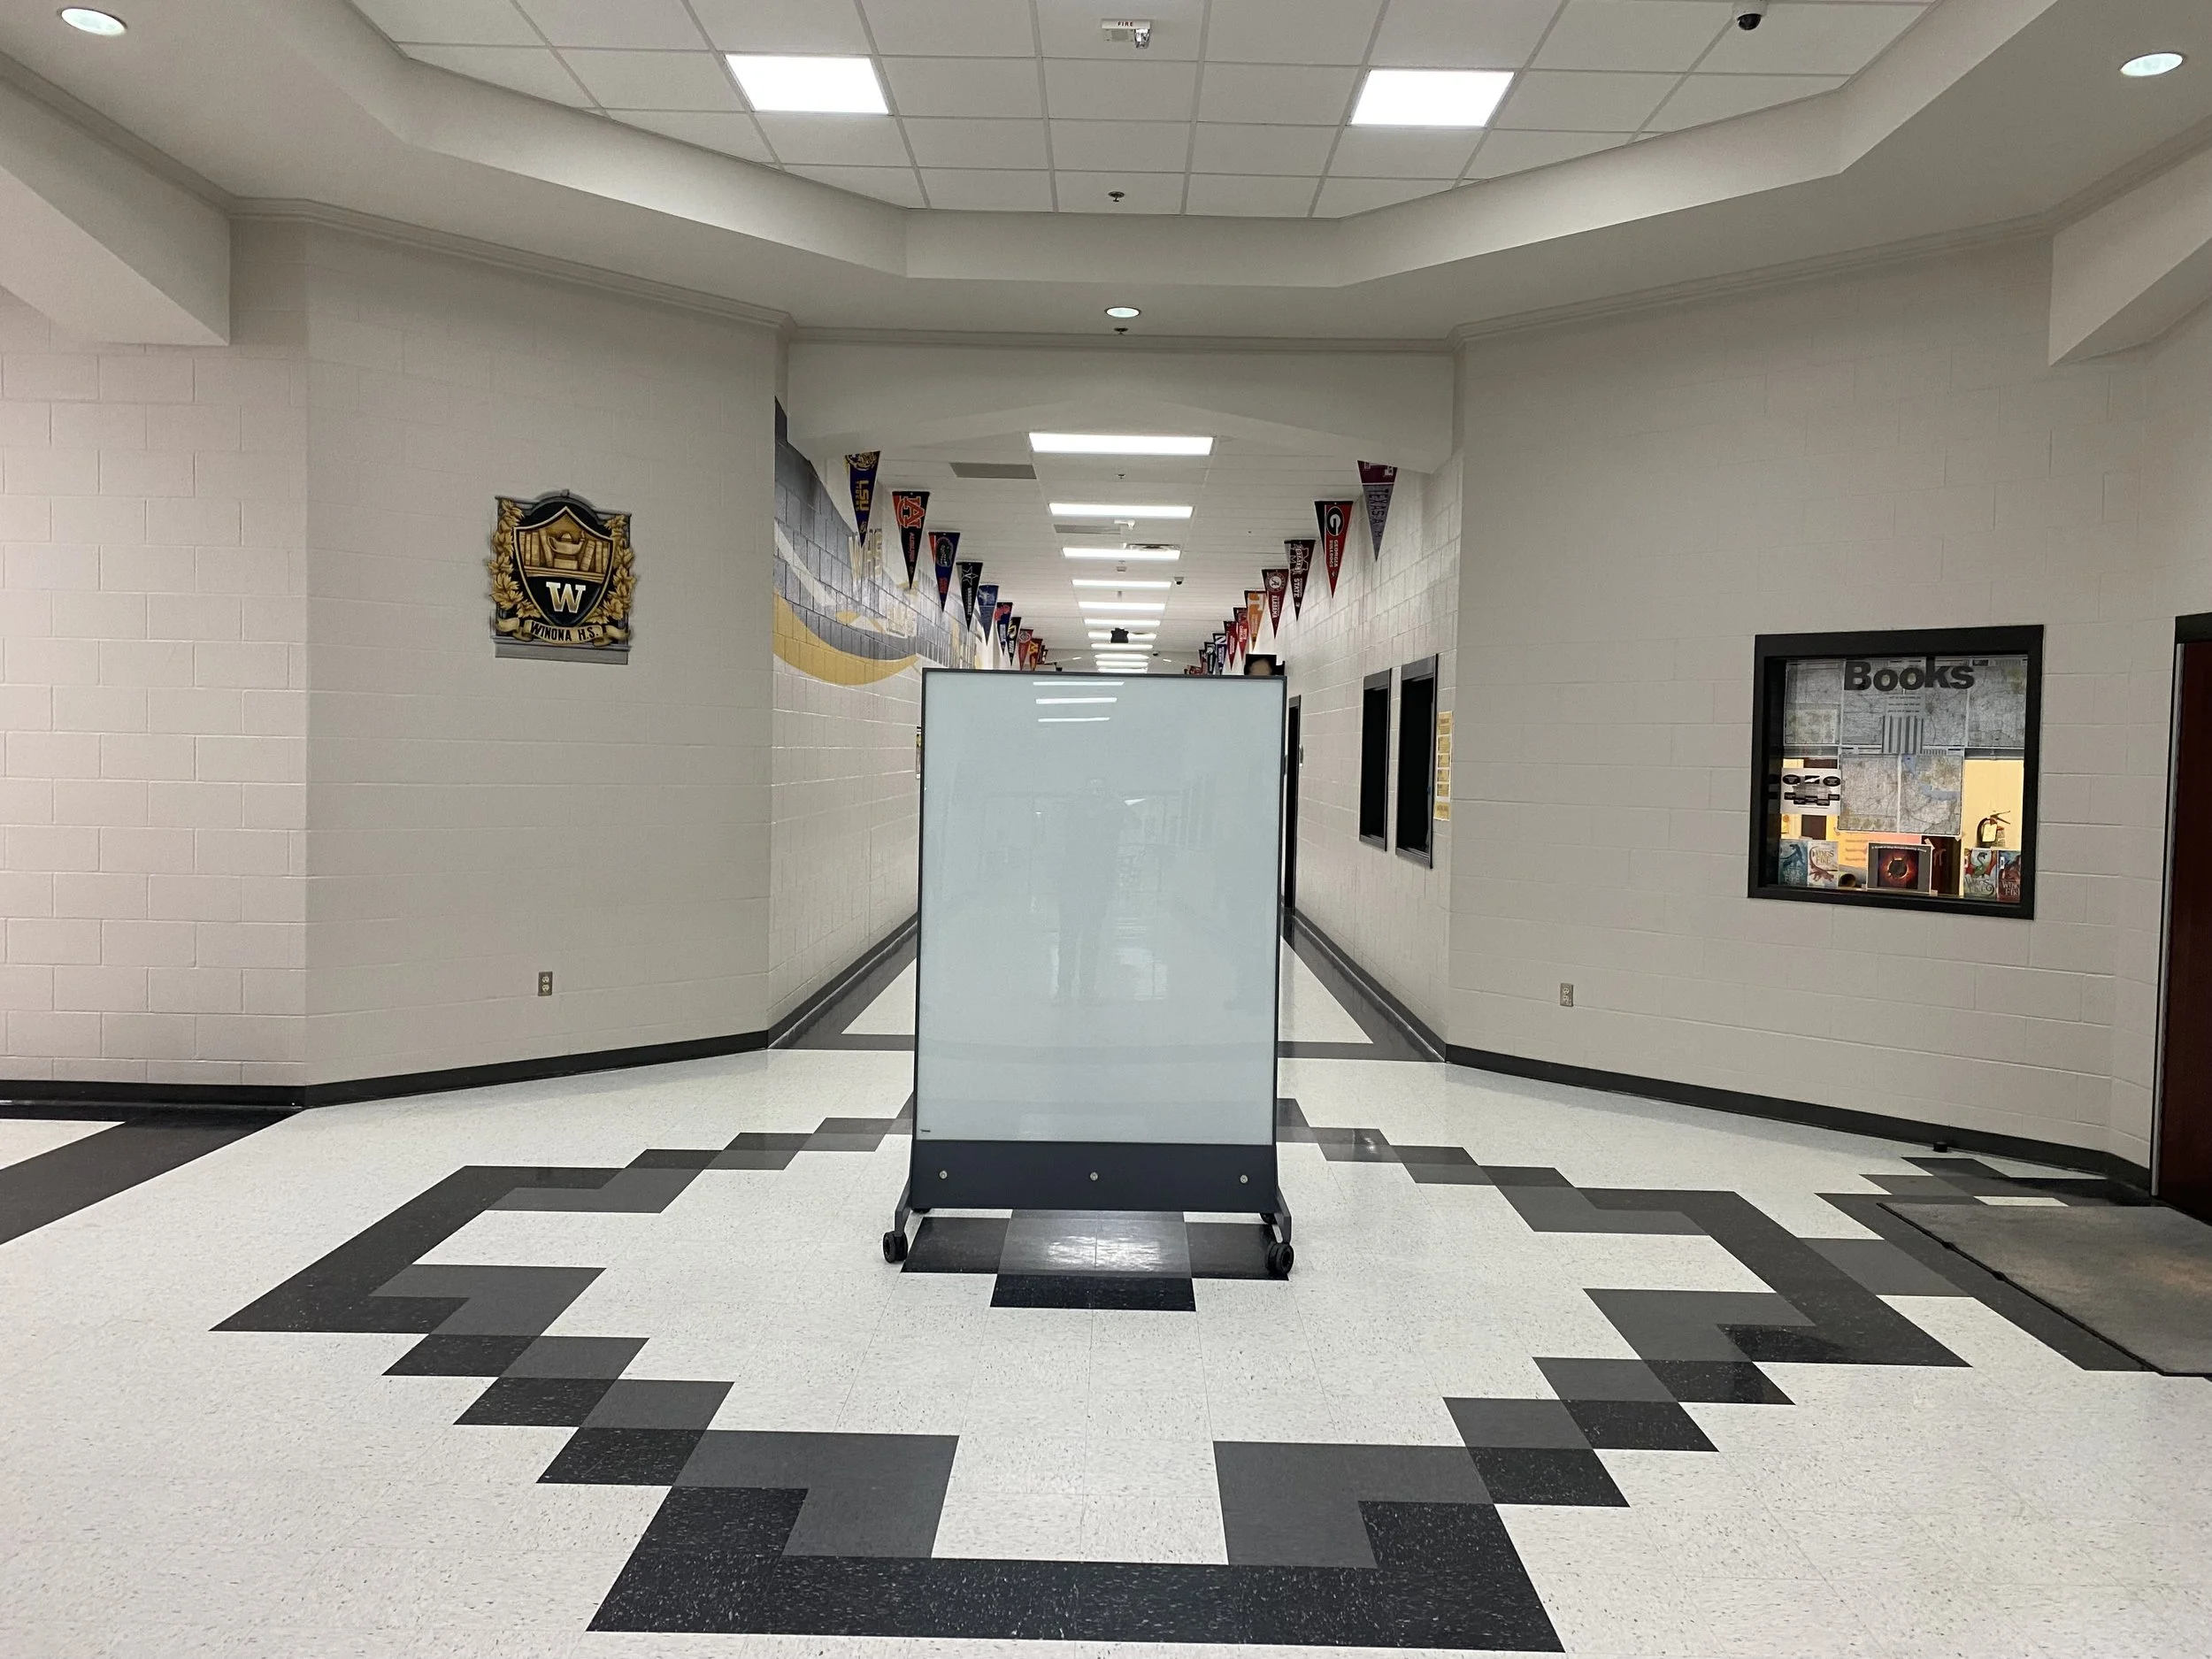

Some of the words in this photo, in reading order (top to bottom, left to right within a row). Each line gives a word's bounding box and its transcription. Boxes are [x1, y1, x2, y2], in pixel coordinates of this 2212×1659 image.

[859, 480, 870, 511] LSU
[1368, 488, 1389, 516] TEXAS
[546, 581, 587, 613] W
[530, 621, 572, 641] WINONA
[578, 626, 599, 641] H.S.
[1844, 656, 1975, 691] Books
